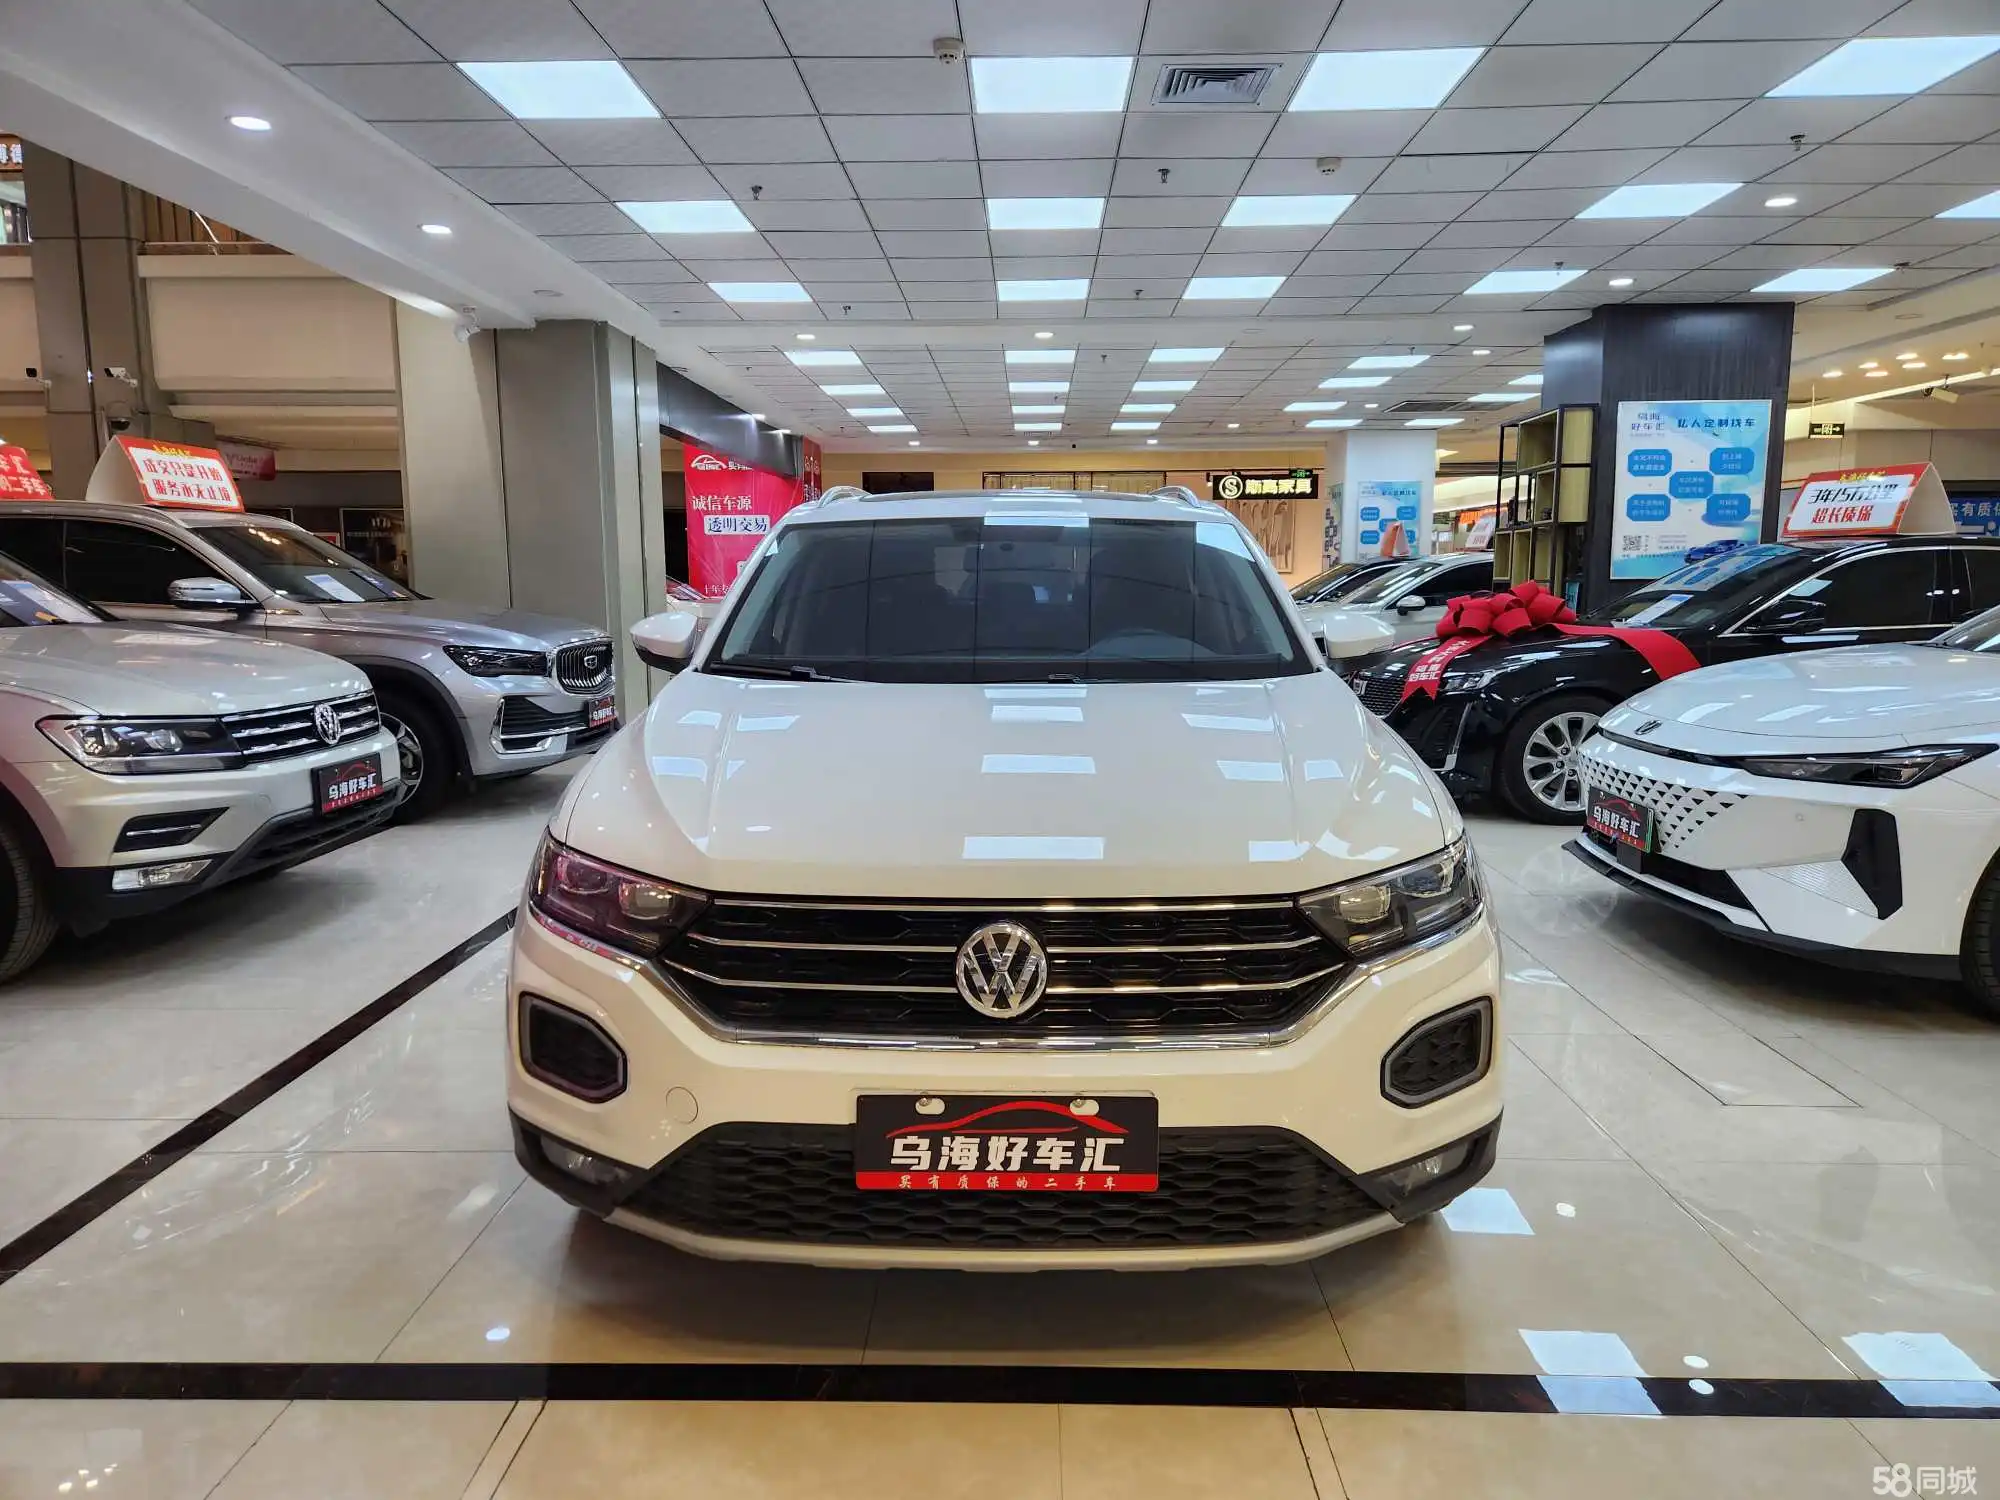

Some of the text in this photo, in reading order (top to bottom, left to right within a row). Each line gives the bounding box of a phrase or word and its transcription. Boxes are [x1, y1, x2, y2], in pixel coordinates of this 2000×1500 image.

[691, 495, 752, 511] 诚信车源
[708, 517, 768, 532] 透明交易
[329, 773, 377, 799] 乌海好车汇
[1593, 805, 1640, 838] 乌海好车汇
[890, 1135, 1125, 1172] 乌海好车汇
